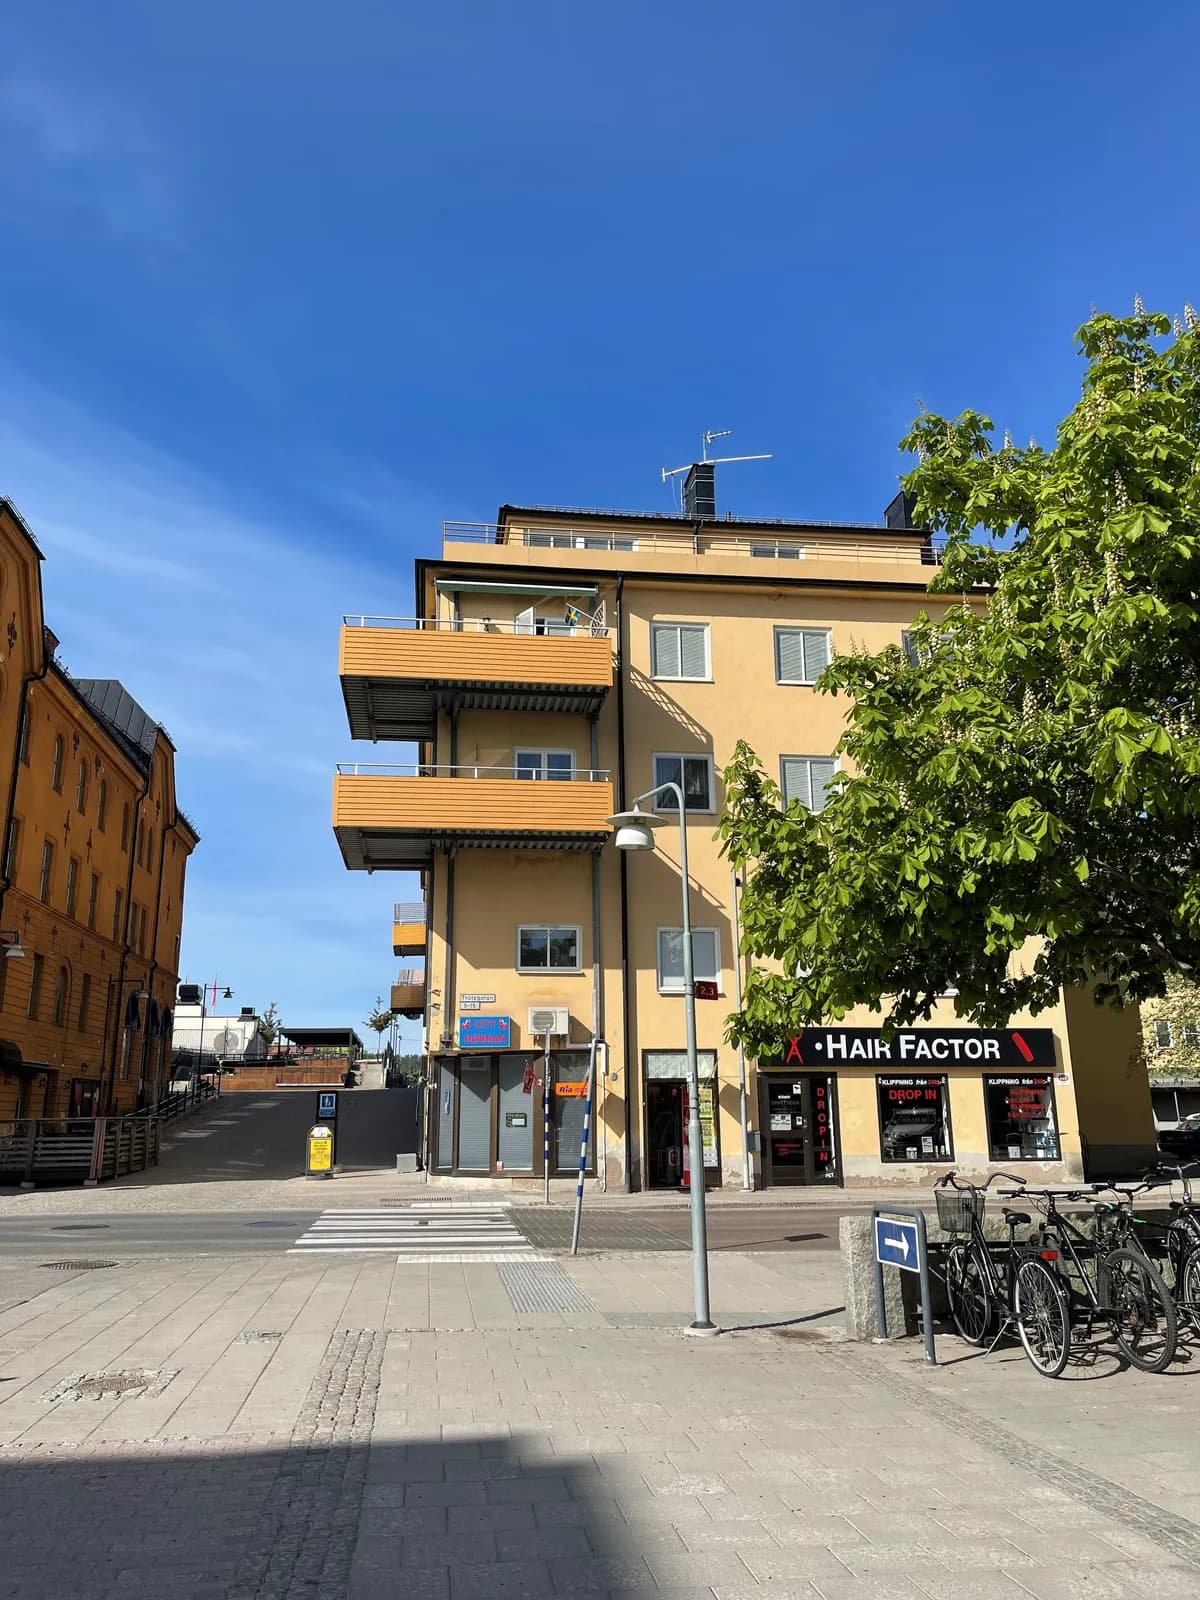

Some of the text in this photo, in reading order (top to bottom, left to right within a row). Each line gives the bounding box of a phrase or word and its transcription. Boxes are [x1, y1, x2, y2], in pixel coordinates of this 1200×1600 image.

[900, 1034, 1001, 1060] FACTOR
[559, 1085, 573, 1093] Ria
[889, 1089, 937, 1100] DROP IN
